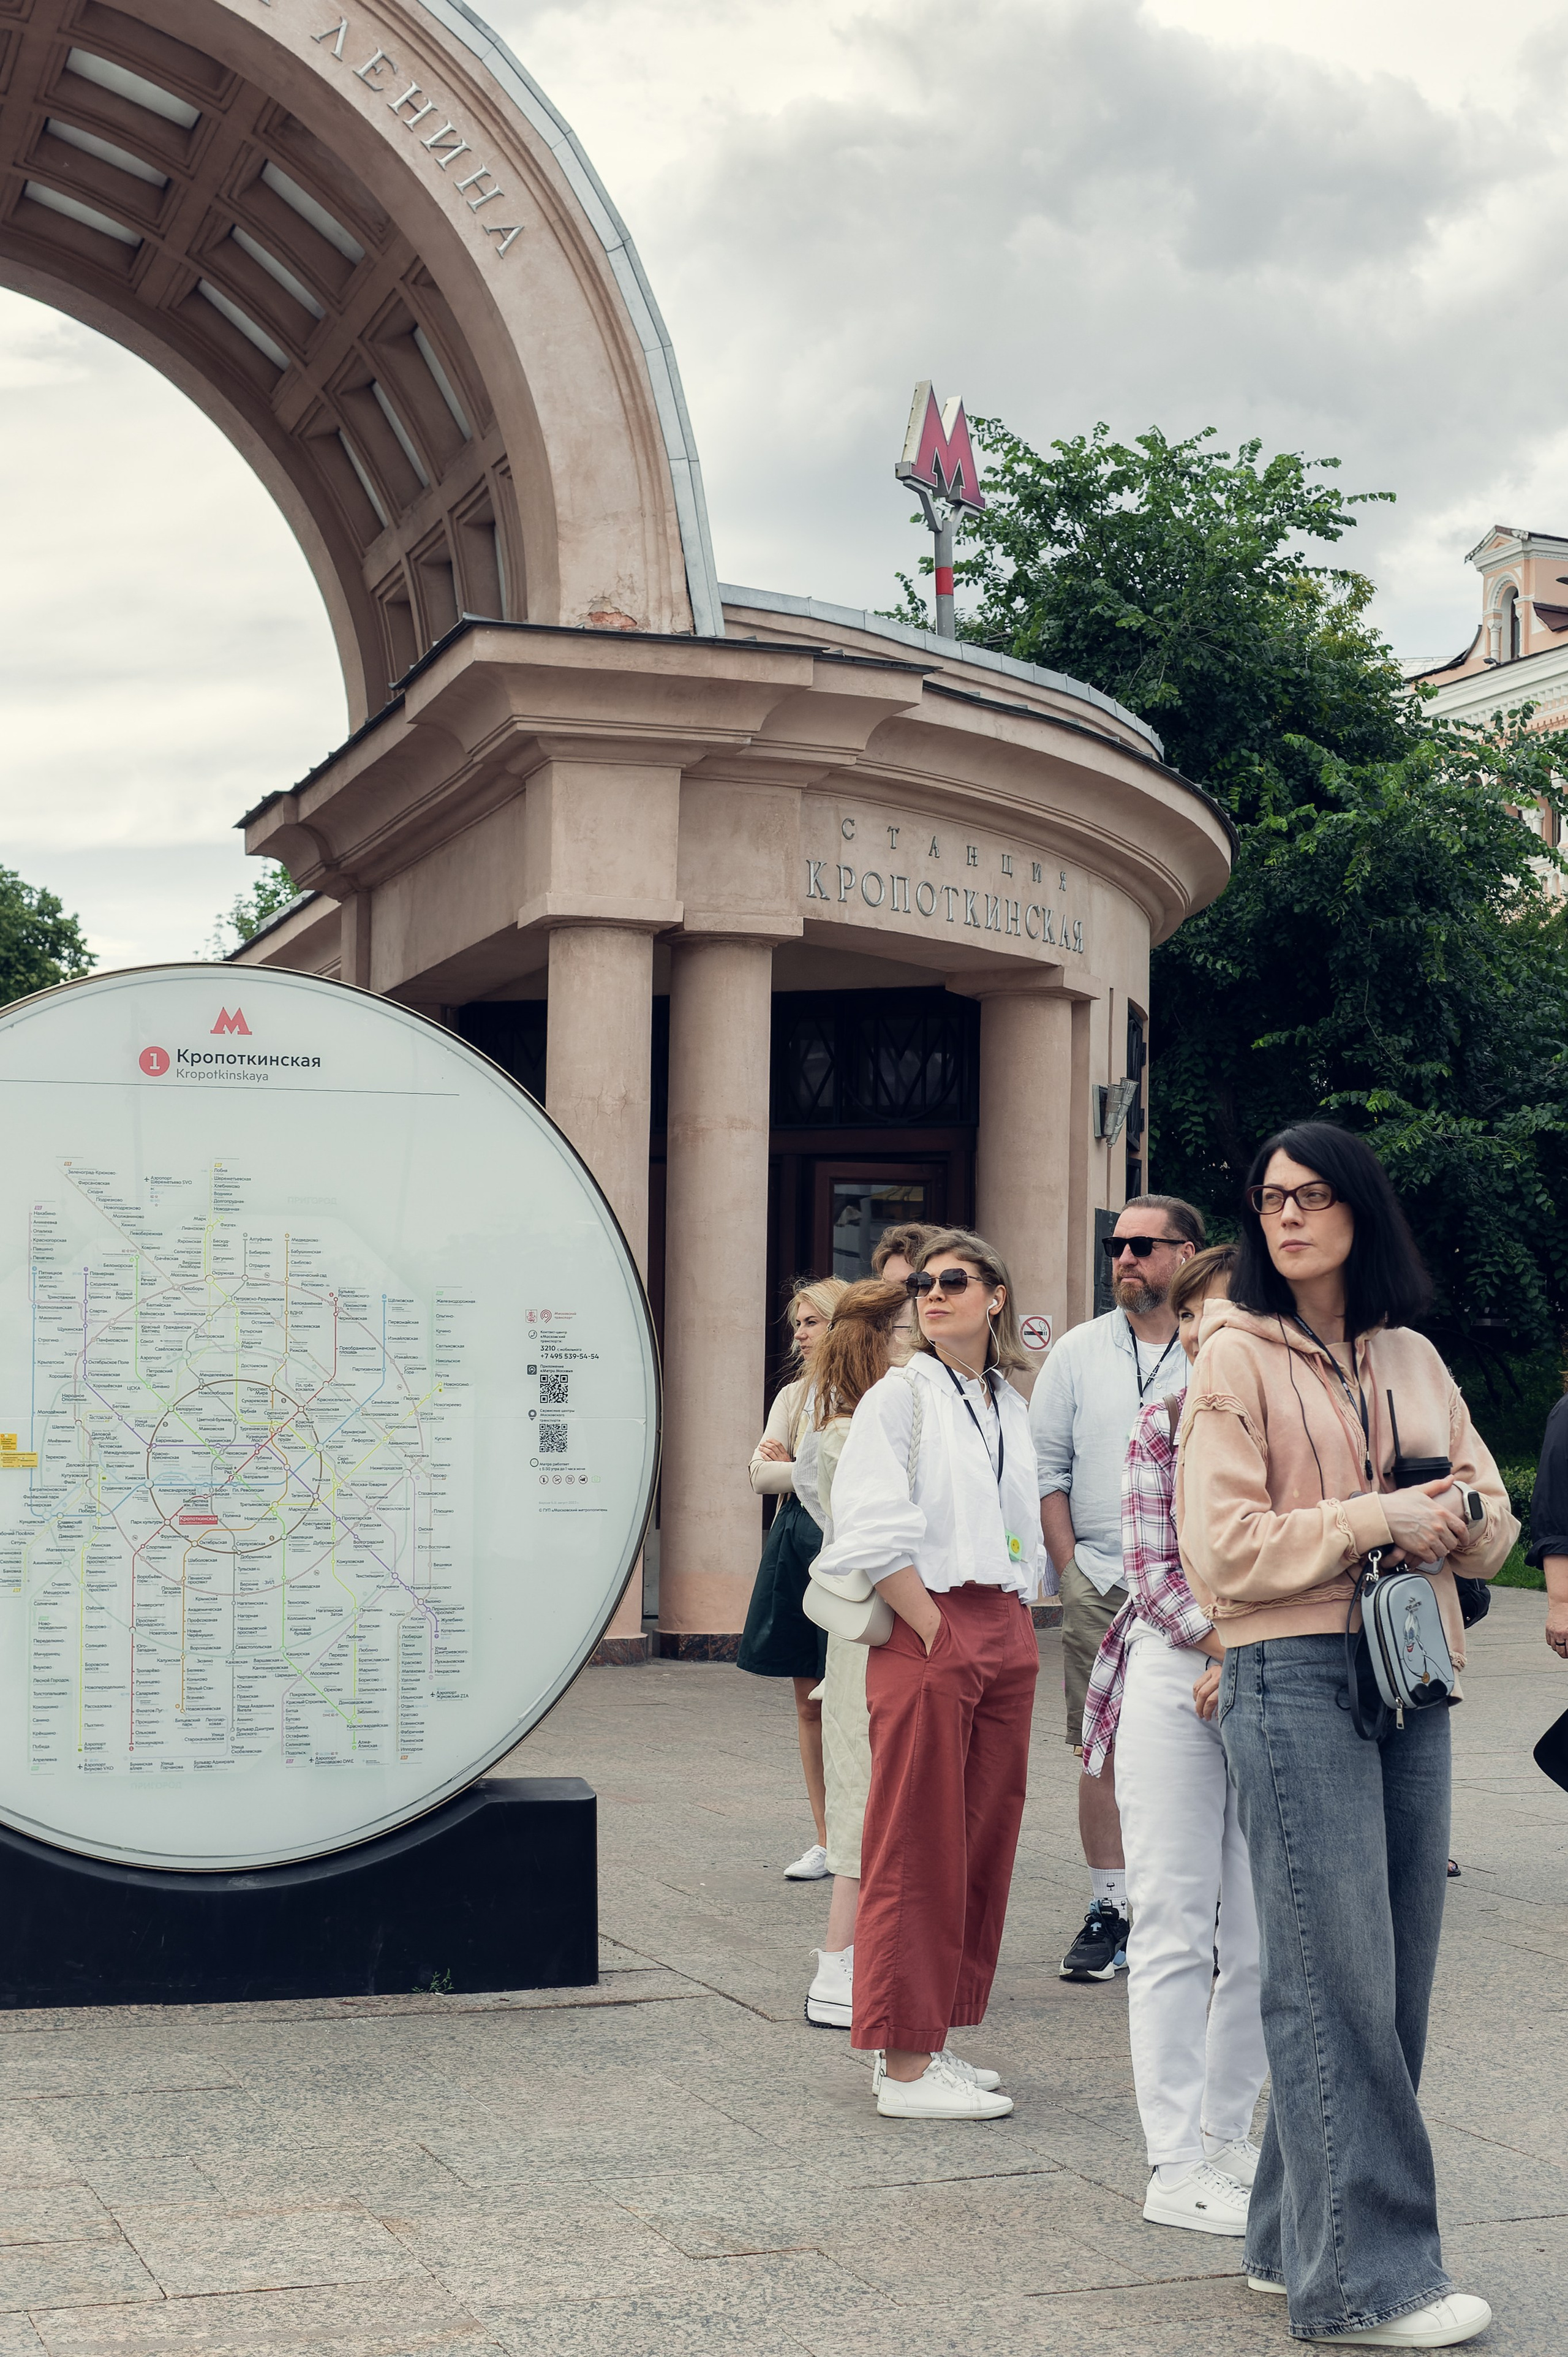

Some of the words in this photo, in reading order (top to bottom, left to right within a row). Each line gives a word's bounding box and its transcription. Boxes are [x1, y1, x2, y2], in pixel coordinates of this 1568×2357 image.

[311, 16, 524, 259] ЛЕНИНА
[842, 817, 1067, 891] СТАНЦИЯ
[806, 859, 1084, 953] КРОПОТКИНСКАЯ
[176, 1069, 269, 1083] Kropotkinskaya
[177, 1048, 321, 1067] Кропоткинская
